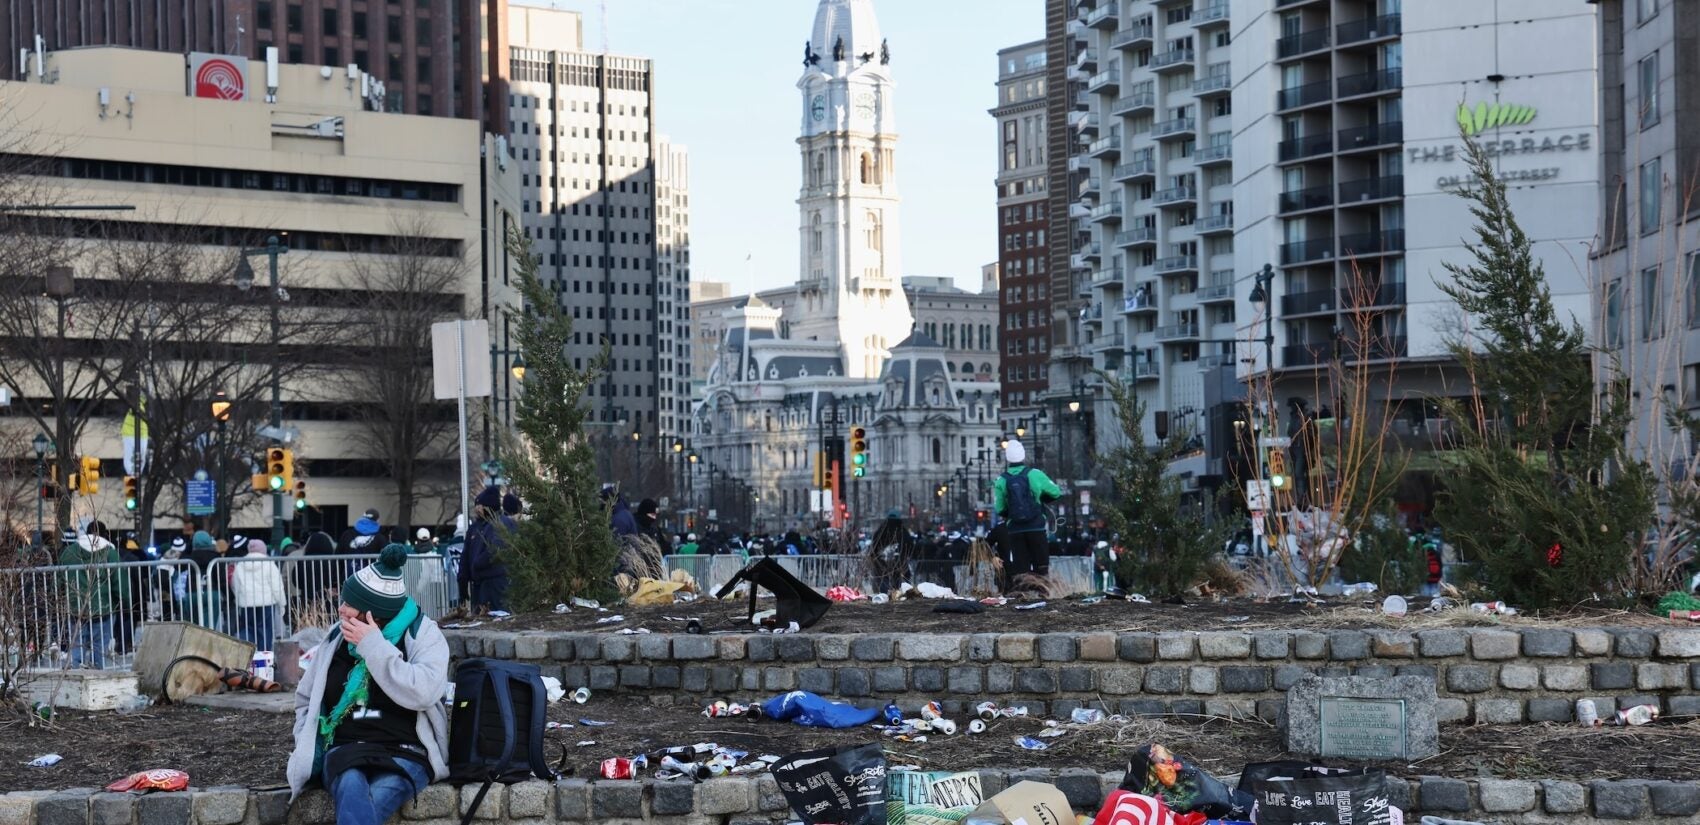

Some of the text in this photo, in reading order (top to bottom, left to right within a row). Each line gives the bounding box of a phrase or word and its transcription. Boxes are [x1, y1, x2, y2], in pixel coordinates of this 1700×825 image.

[1407, 133, 1590, 163] THE ERRACE
[1437, 175, 1460, 189] ON
[1501, 167, 1560, 183] STREET
[807, 773, 826, 789] EAT
[844, 764, 886, 786] ShopRite
[907, 773, 981, 808] FAMER'S
[1265, 791, 1335, 809] LIVE Love EAT
